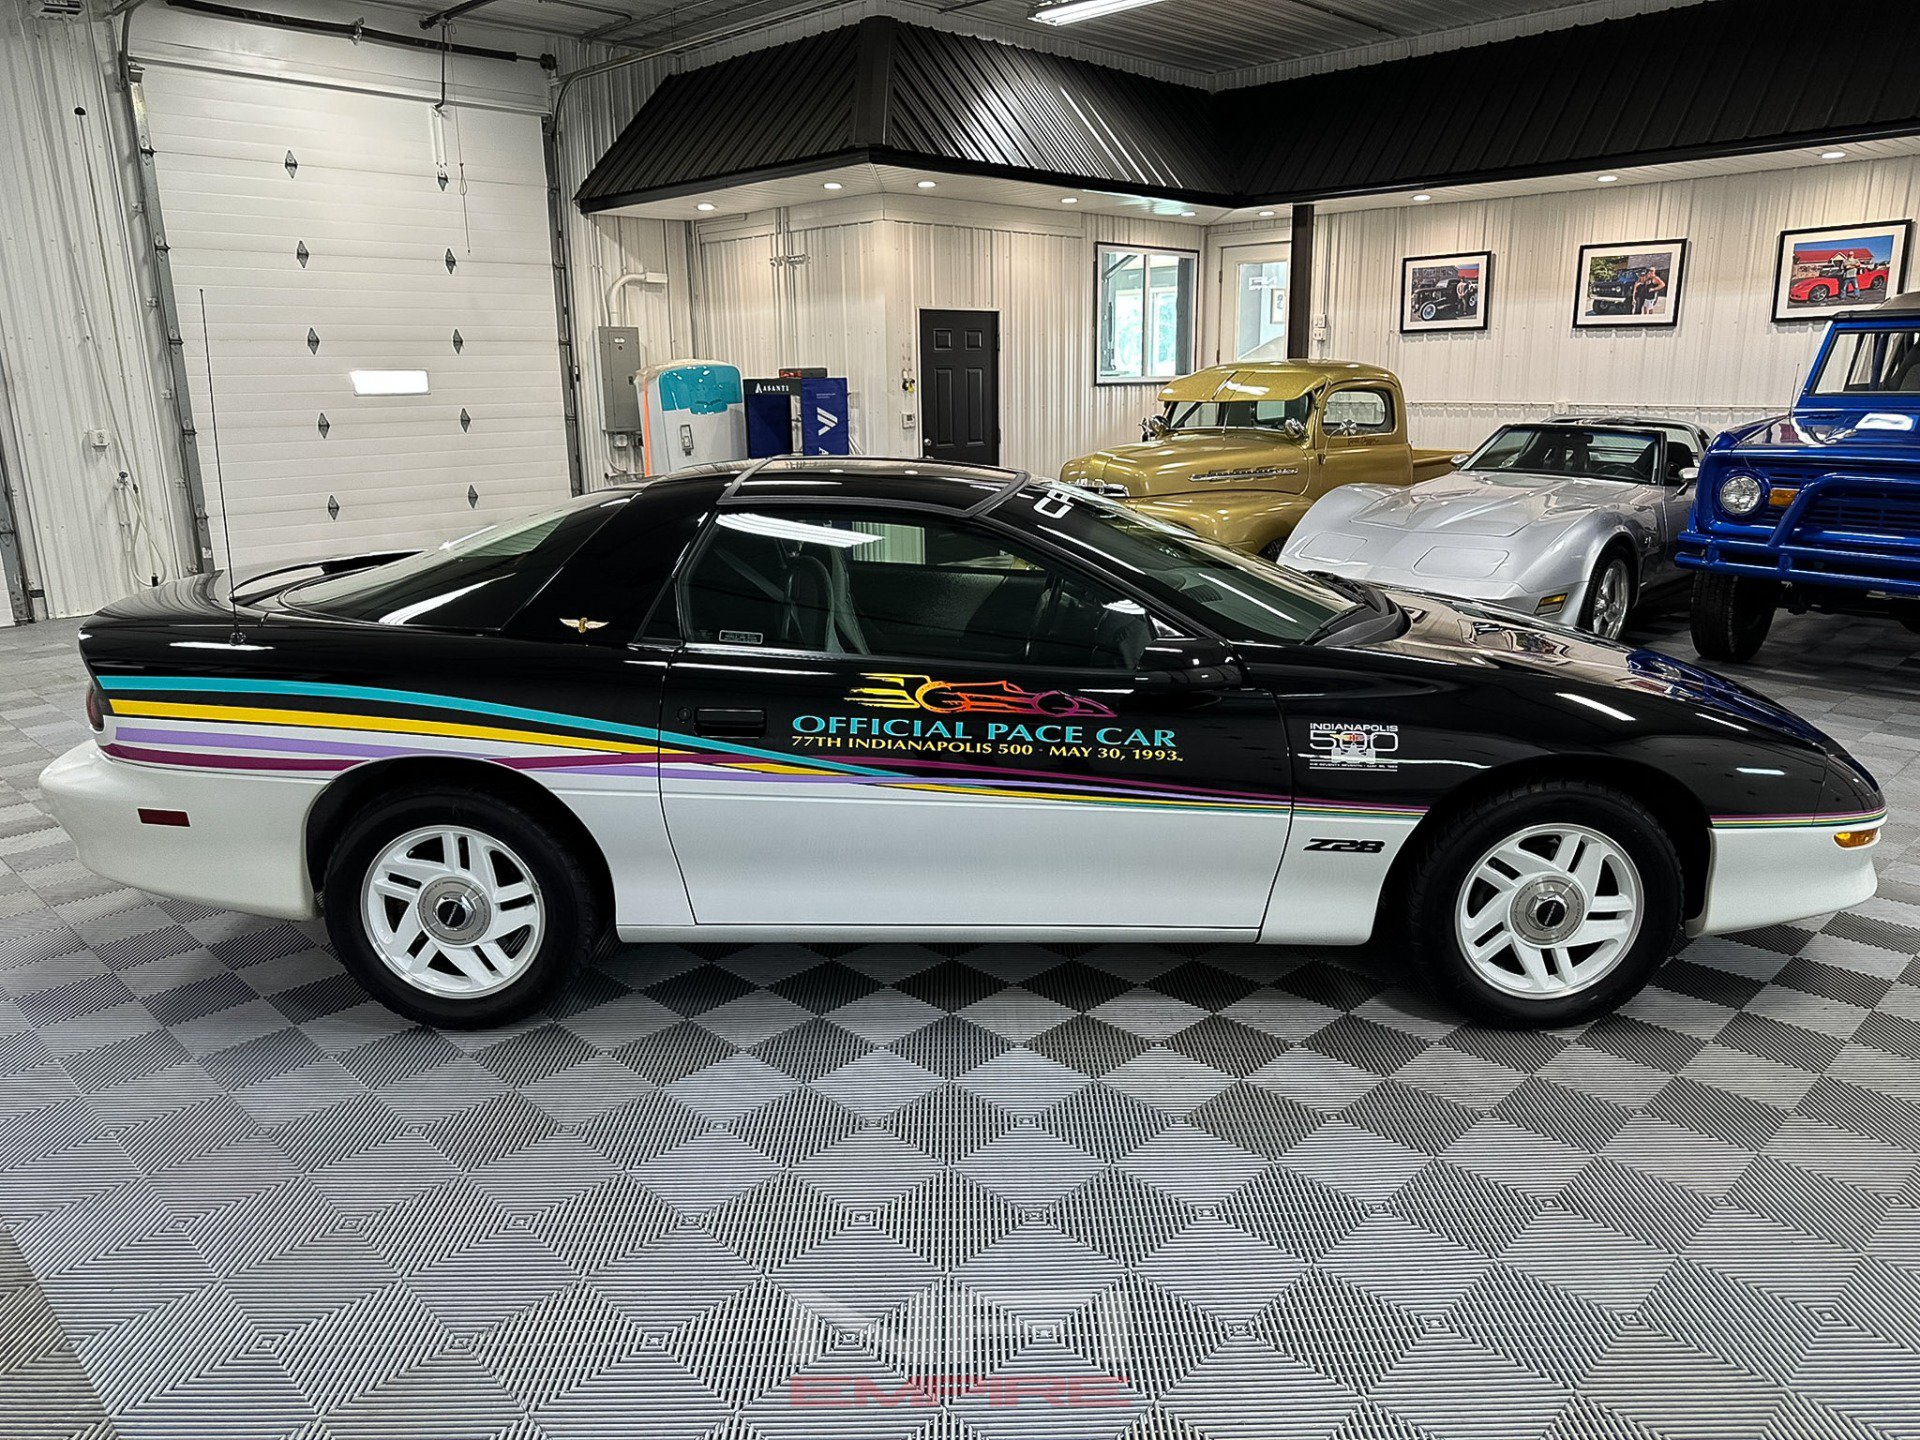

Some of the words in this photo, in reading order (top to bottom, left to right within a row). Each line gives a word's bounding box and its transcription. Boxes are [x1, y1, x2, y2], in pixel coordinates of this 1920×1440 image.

[792, 715, 973, 739] OFFICIAL
[987, 722, 1084, 744] PACE
[1096, 727, 1177, 748] CAR
[1309, 722, 1399, 732] INDIANAPOLIS
[792, 735, 842, 748] 77TH
[848, 737, 993, 754] INDIANAPOLIS
[998, 743, 1034, 756] 500
[1049, 745, 1093, 758] MAY
[1097, 747, 1126, 761] 30,
[1309, 730, 1399, 752] 500
[1303, 838, 1386, 853] Z28
